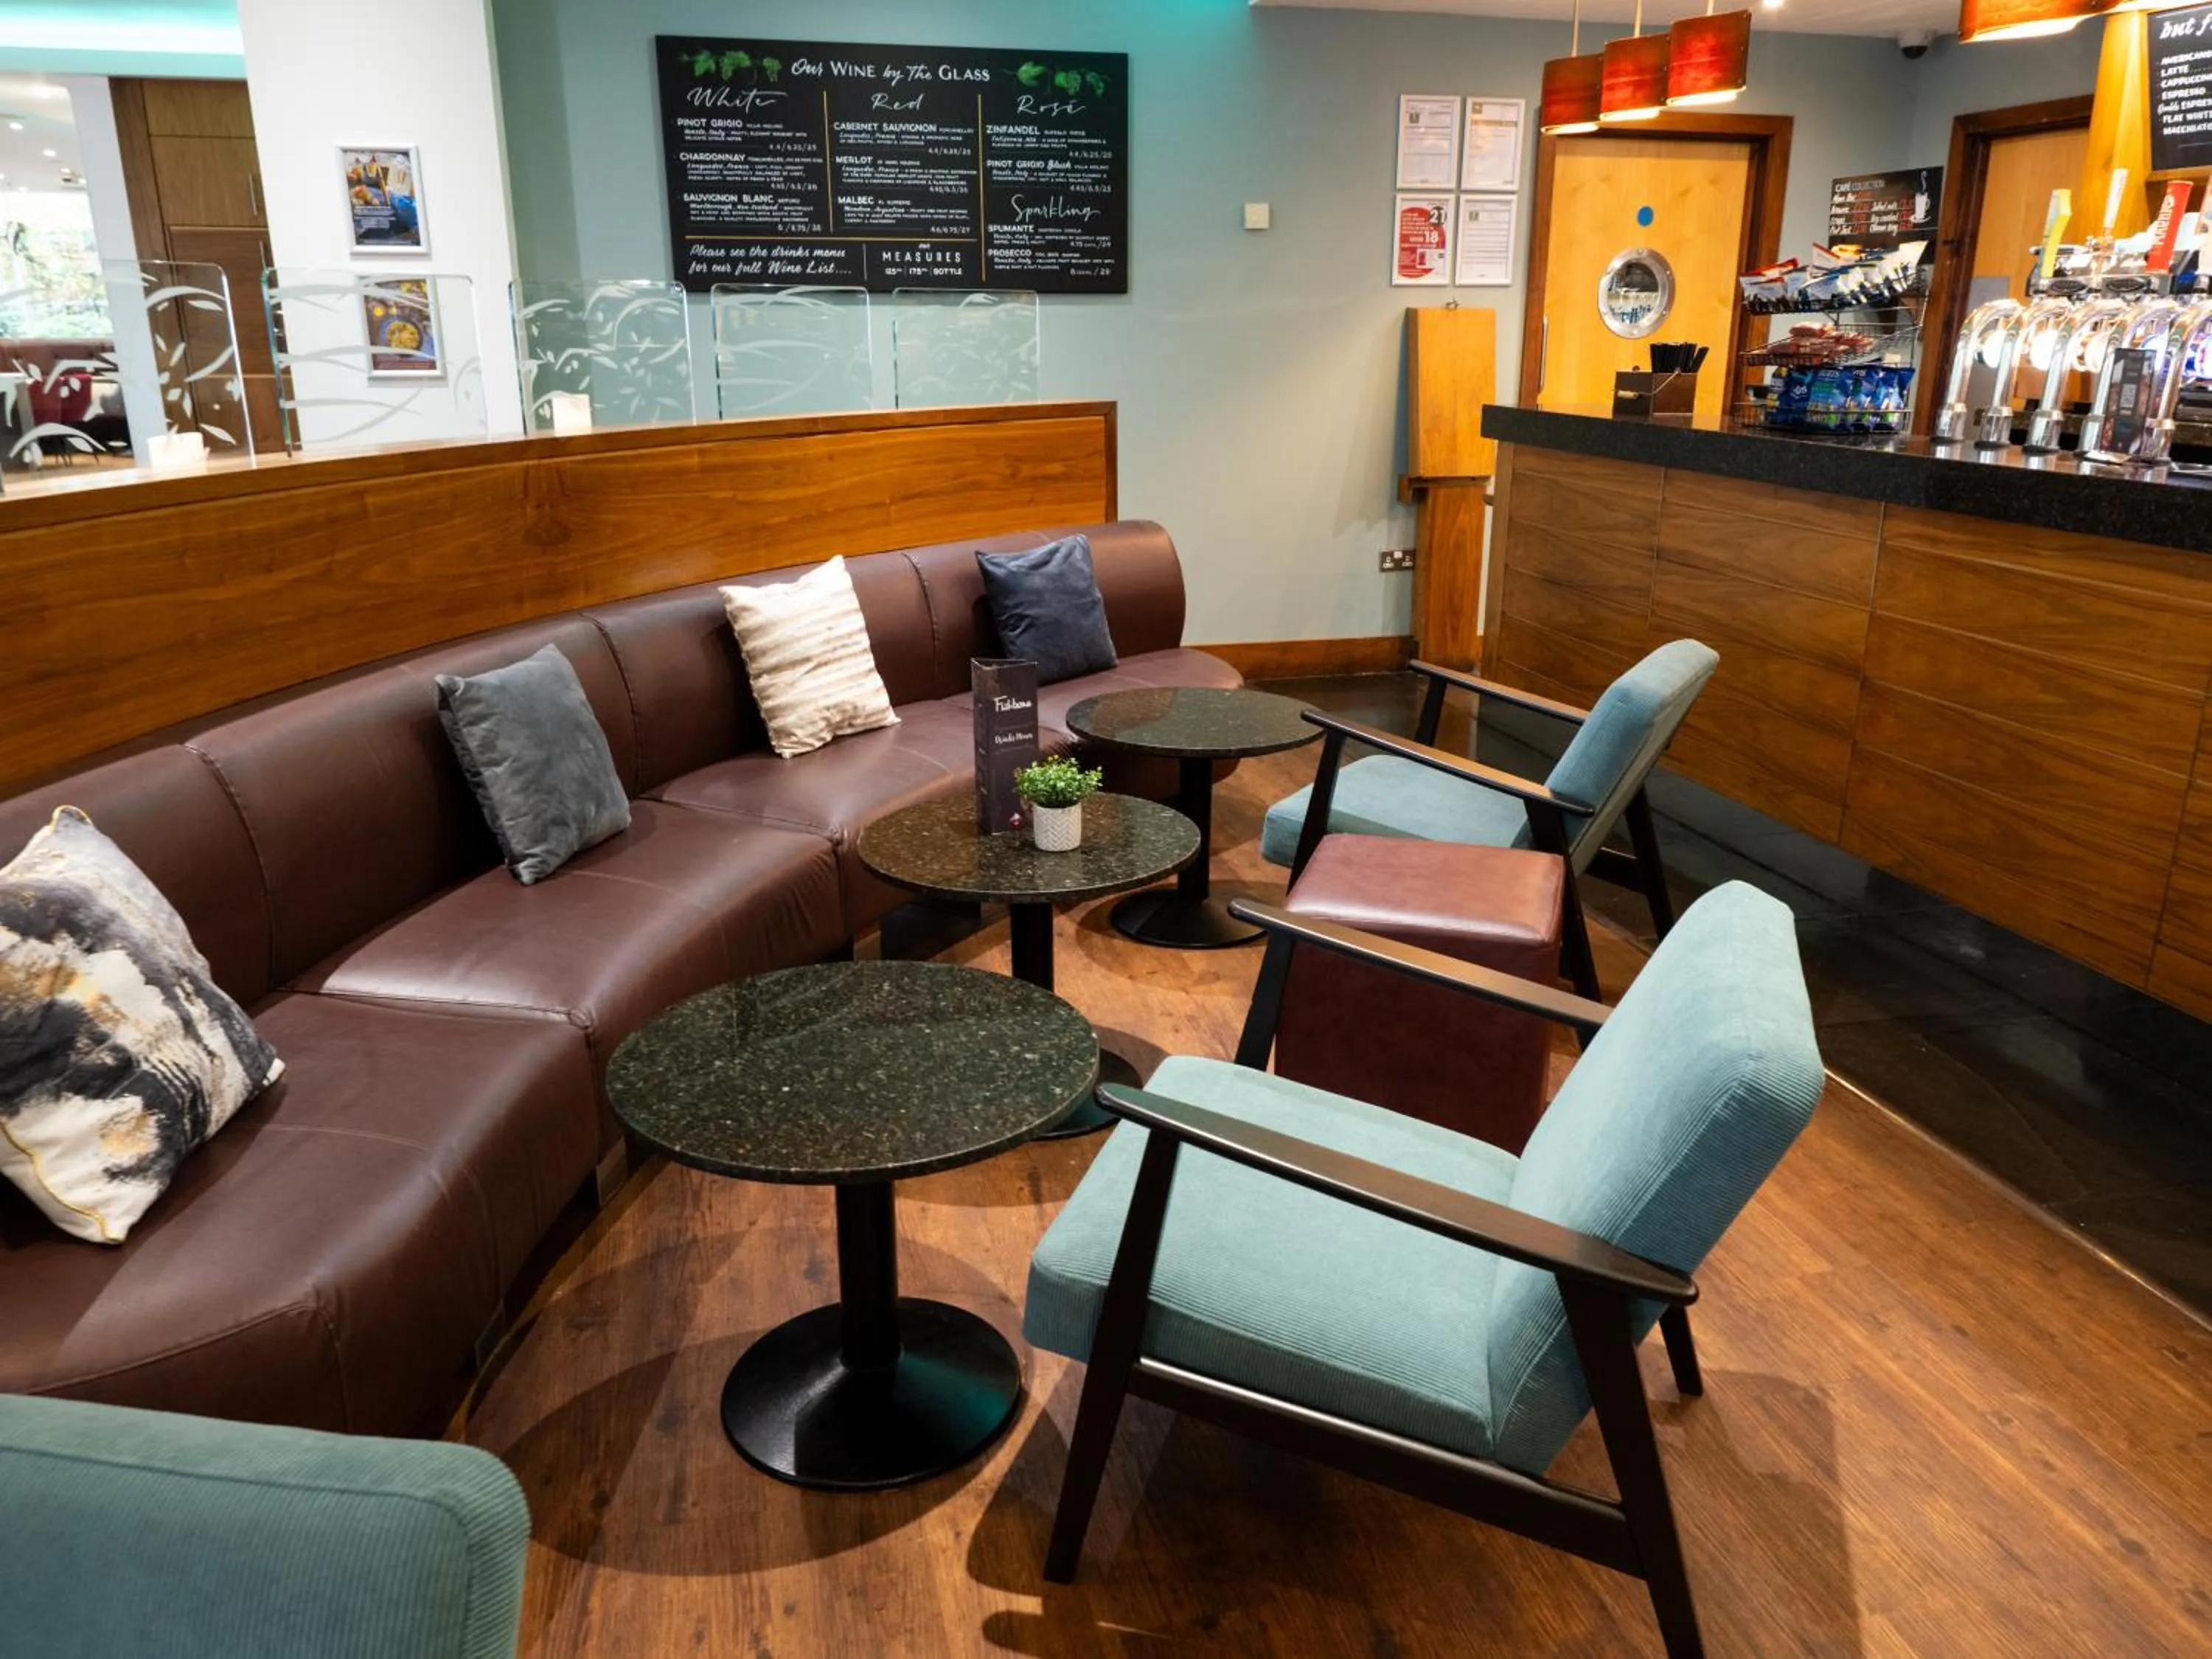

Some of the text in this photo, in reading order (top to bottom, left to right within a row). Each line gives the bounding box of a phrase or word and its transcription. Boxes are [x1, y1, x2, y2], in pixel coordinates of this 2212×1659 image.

[2159, 17, 2196, 39] but
[791, 58, 824, 76] Our
[830, 60, 876, 77] WINE
[883, 64, 903, 86] by
[939, 64, 991, 82] GLASS
[2161, 64, 2189, 77] LATTE
[687, 86, 788, 114] White
[871, 93, 925, 111] Red
[677, 118, 707, 128] PINOT
[710, 119, 743, 128] GRIGIO
[833, 122, 878, 131] CABERNET
[883, 122, 936, 133] SAUVIGNON
[986, 125, 1040, 135] ZINFANDEL
[680, 153, 745, 161] CHARDONNAY
[835, 156, 873, 164] MERLOT
[987, 160, 1012, 168] PINOT
[1016, 160, 1045, 168] GRIGIO
[684, 193, 737, 202] SAUVIGNON
[742, 194, 774, 203] BLANC
[838, 196, 874, 204] MALBEC
[1011, 194, 1102, 222] Sparkling
[987, 224, 1034, 233] SPUMANTE
[1425, 230, 1439, 243] 18
[690, 244, 846, 257] Please see the drinks menu
[882, 251, 961, 262] MEASURES
[688, 261, 708, 275] for
[712, 264, 731, 273] our
[735, 261, 762, 276] full
[768, 261, 803, 274] Wine
